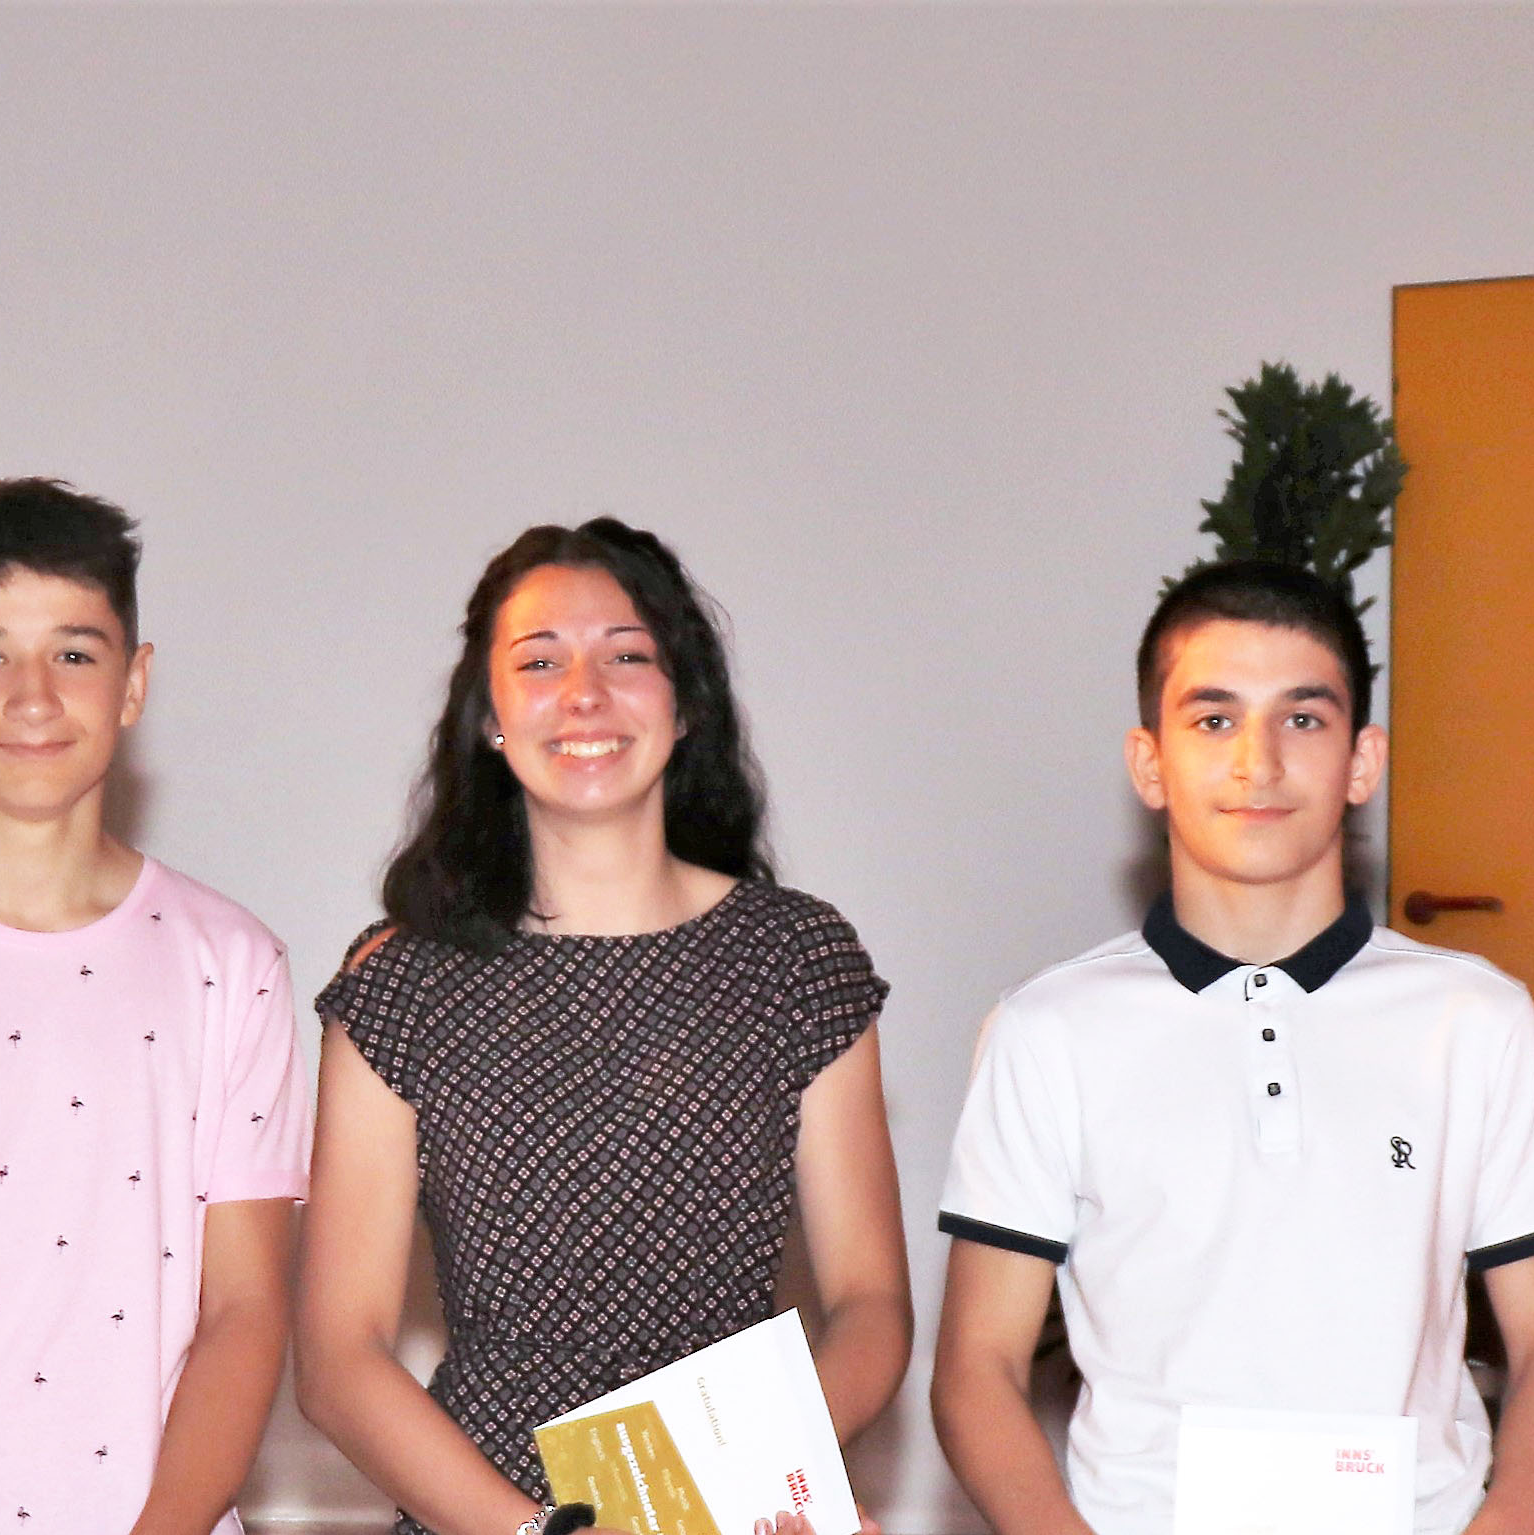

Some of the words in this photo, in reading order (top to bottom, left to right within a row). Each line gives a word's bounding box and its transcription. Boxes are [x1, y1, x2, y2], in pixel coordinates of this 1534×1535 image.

[696, 1376, 728, 1447] Gratulation!
[616, 1422, 661, 1532] ausgezeichneter
[1335, 1461, 1385, 1474] BRUCK
